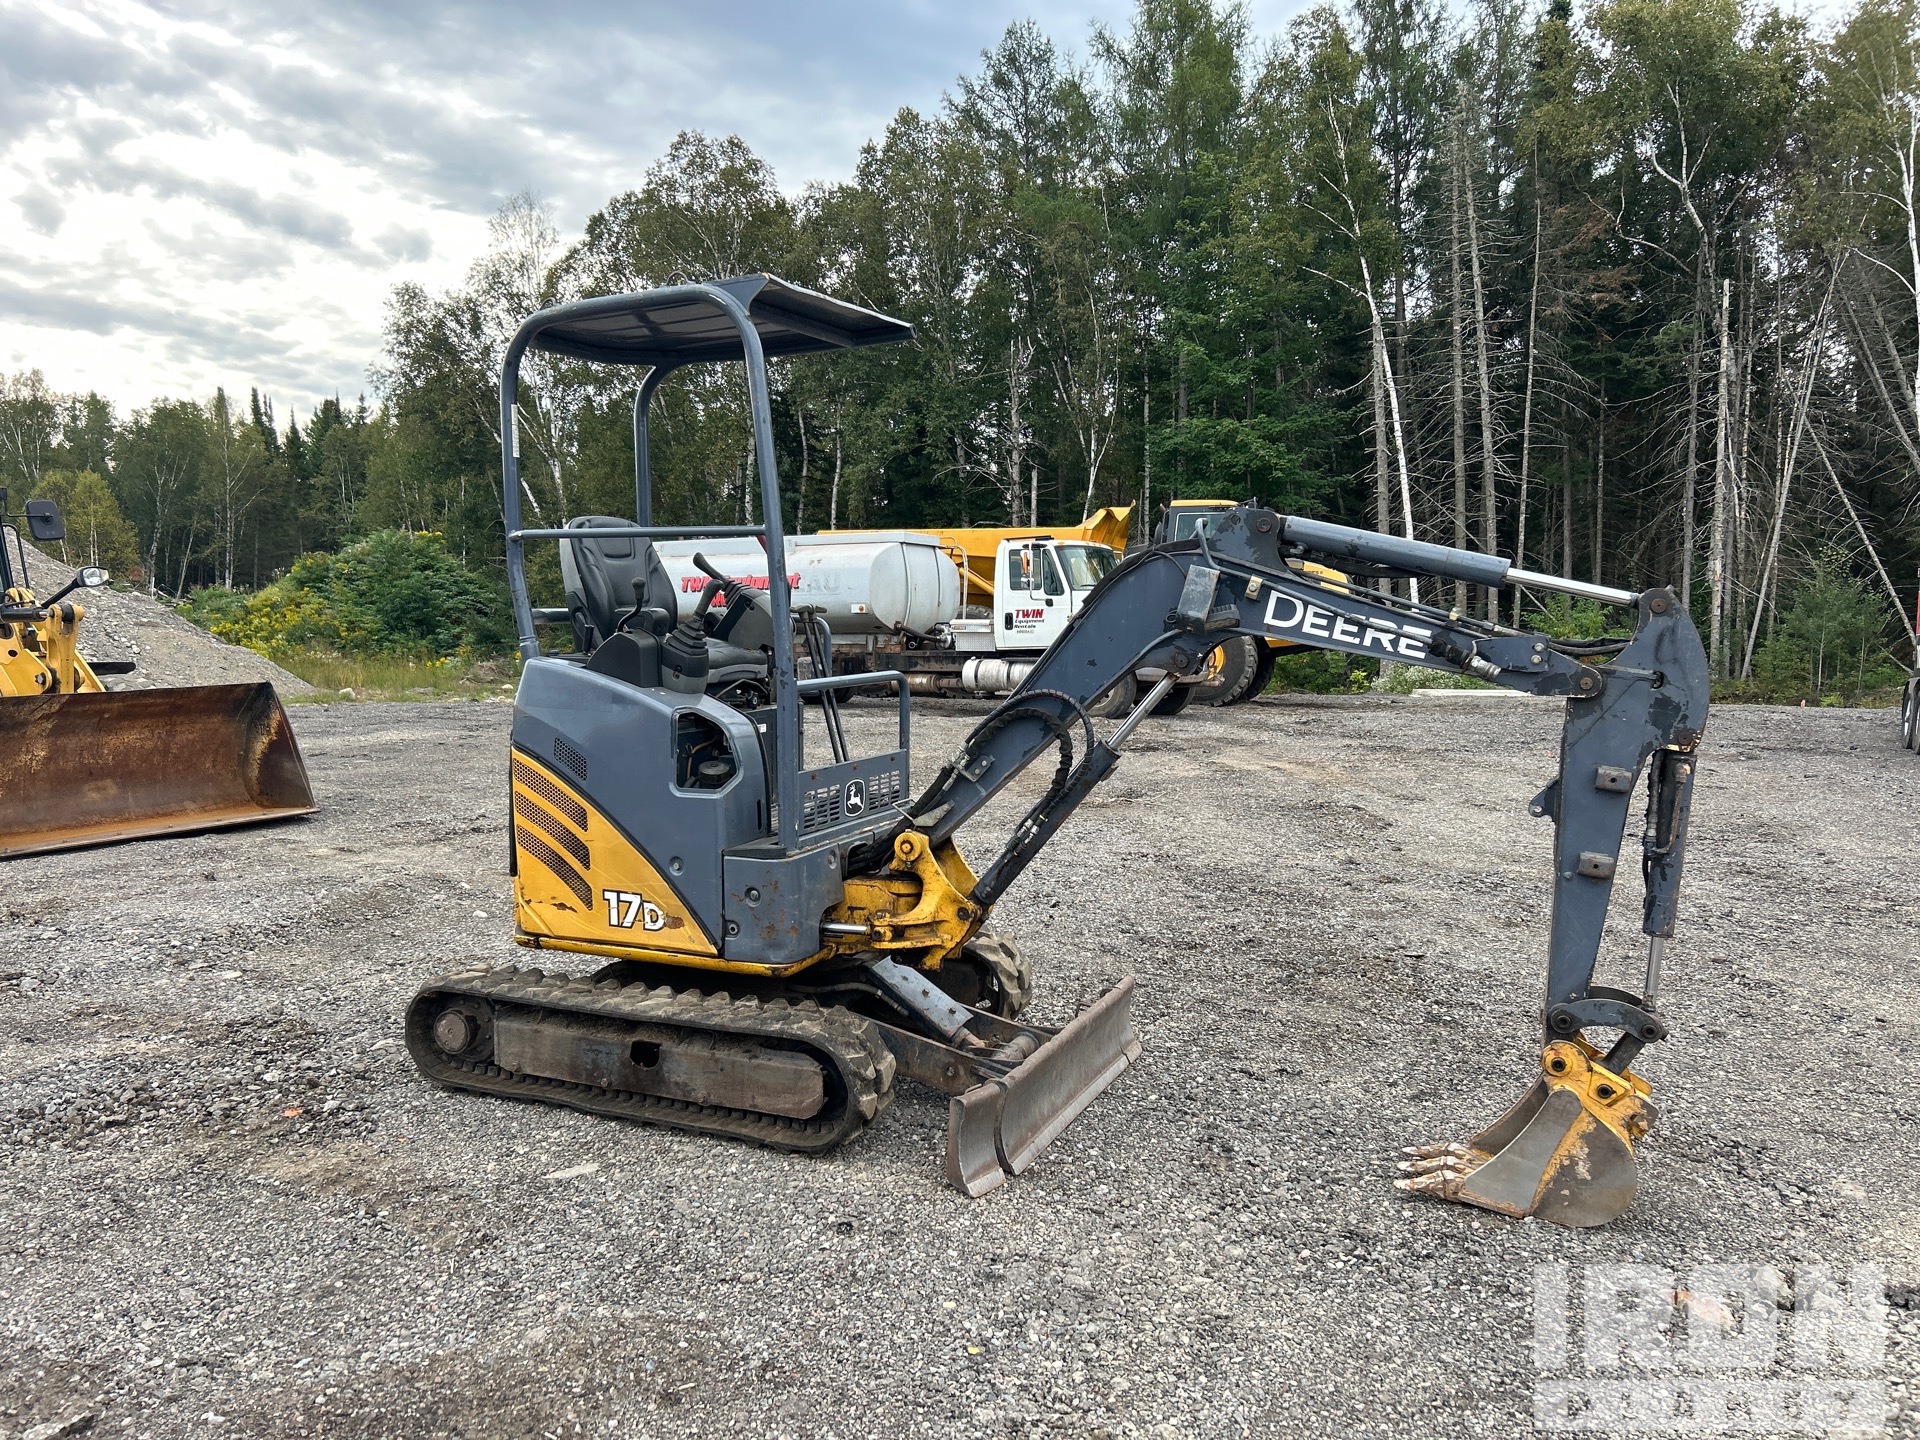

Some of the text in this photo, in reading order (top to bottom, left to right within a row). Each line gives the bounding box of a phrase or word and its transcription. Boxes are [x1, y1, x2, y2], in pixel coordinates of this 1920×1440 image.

[1015, 609, 1044, 619] TWIN
[1263, 590, 1432, 659] DEERE
[602, 889, 666, 932] 17D
